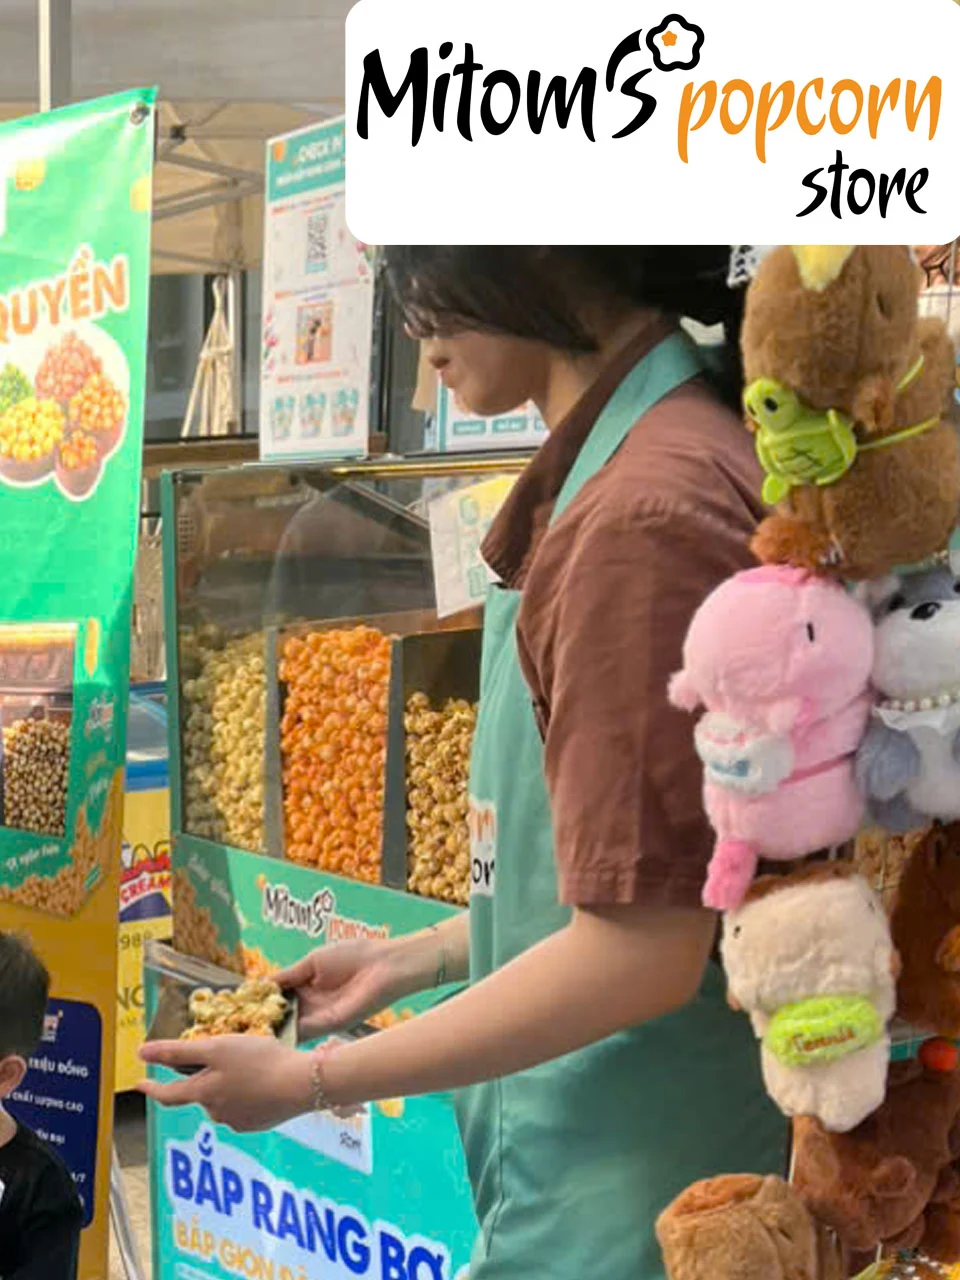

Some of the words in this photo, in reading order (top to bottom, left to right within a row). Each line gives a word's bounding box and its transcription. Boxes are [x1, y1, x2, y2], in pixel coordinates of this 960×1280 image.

[65, 1101, 84, 1114] CAO
[170, 1131, 244, 1217] BẮP
[251, 1179, 371, 1275] RANG
